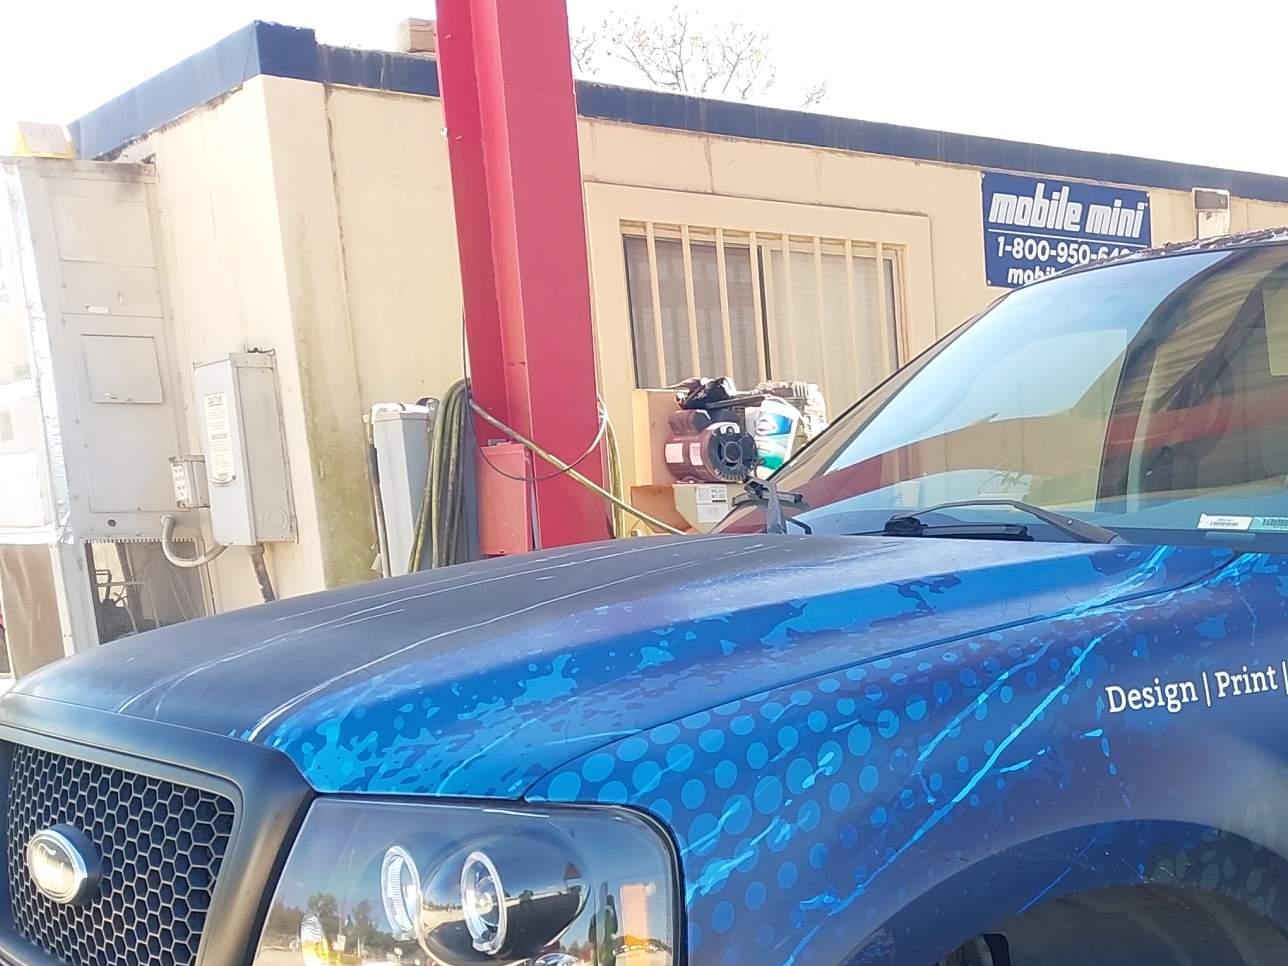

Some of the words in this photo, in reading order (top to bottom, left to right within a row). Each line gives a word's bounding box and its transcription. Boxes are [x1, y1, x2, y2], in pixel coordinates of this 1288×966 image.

[988, 182, 1083, 232] mobile
[1085, 199, 1146, 239] mini
[1105, 678, 1199, 713] Design
[1214, 665, 1279, 698] Print
